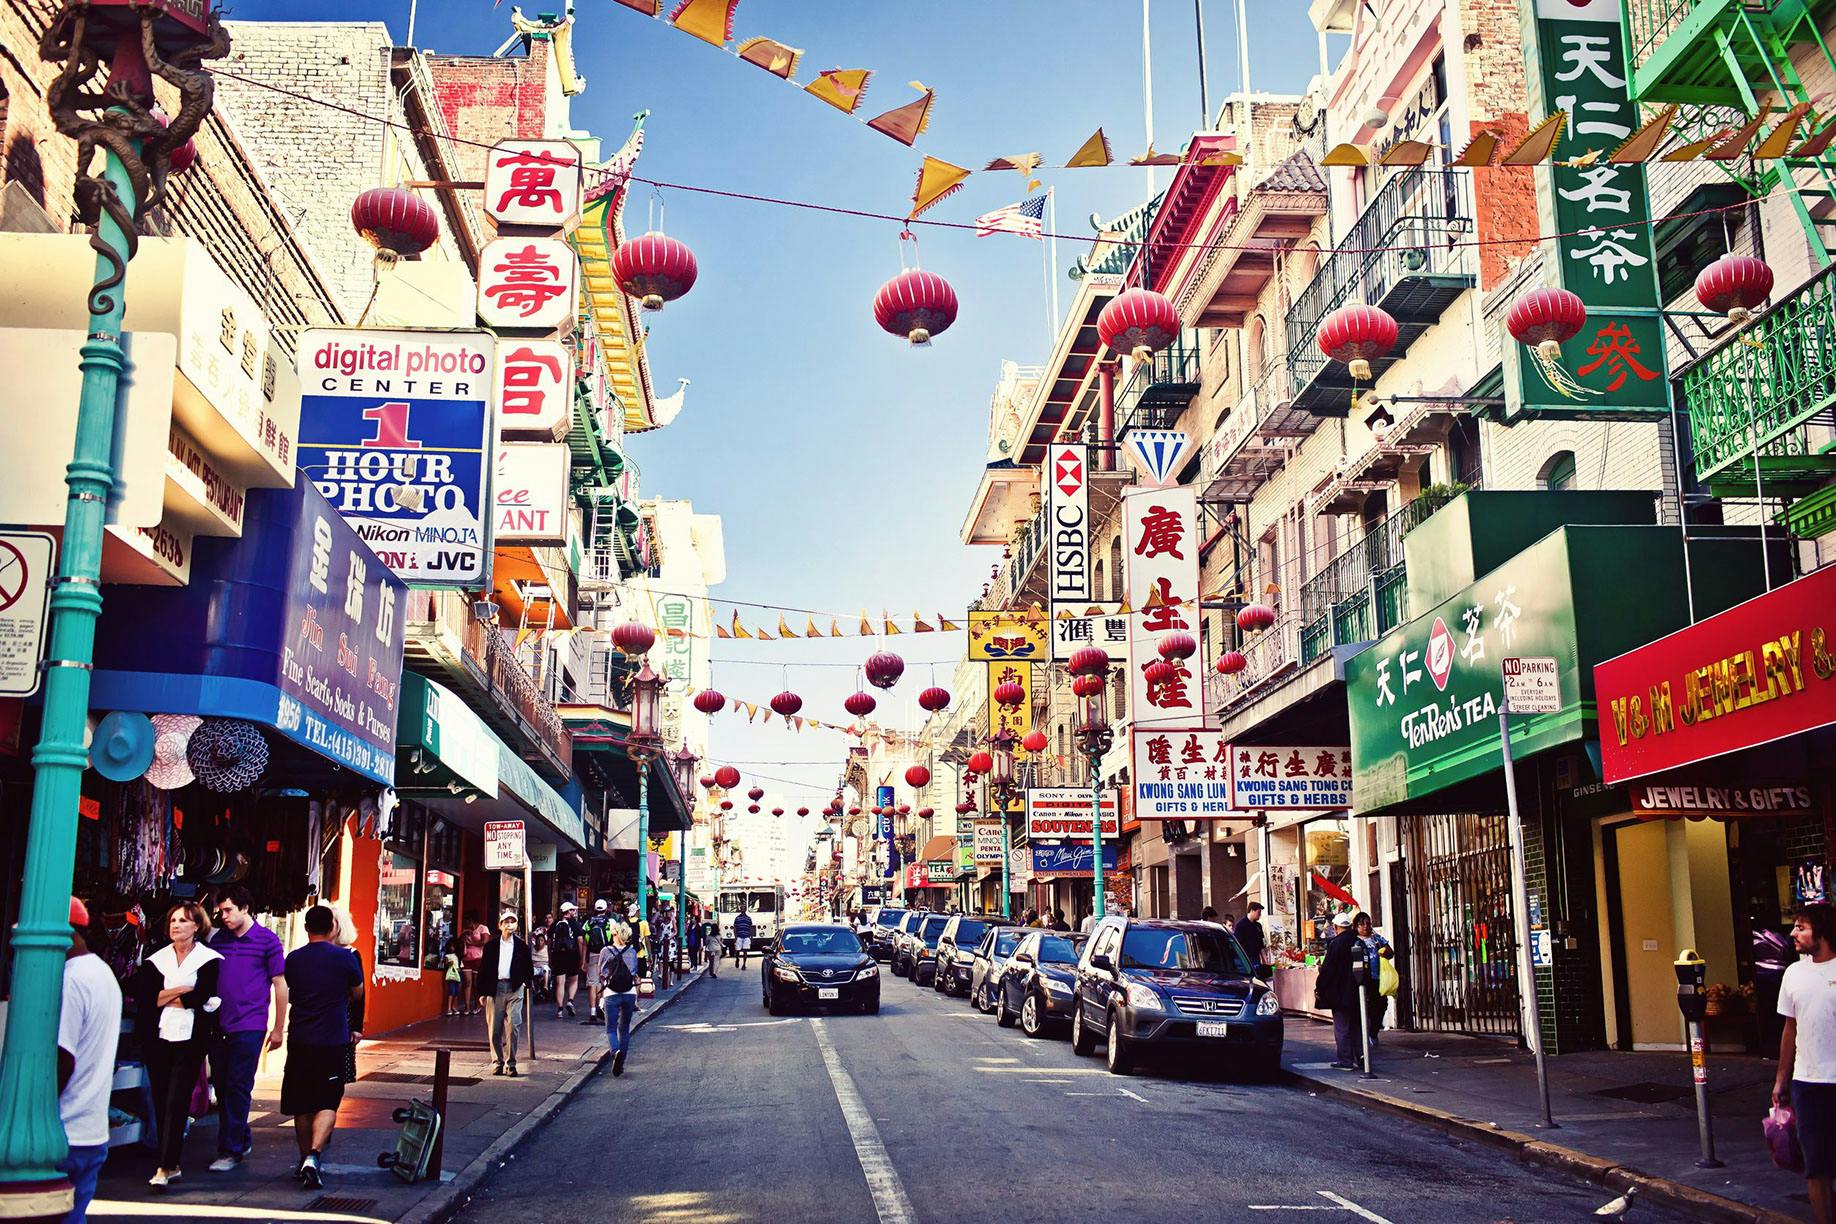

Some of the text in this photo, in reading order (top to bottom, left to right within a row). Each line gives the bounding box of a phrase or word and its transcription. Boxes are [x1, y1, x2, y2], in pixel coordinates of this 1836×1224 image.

[1555, 35, 1648, 285] 天仁茗茶
[314, 342, 485, 377] digital photo
[322, 378, 469, 395] CENTER
[362, 402, 422, 448] 1
[324, 451, 455, 483] HOUR
[203, 462, 244, 526] RESTAURANT
[313, 482, 465, 513] PHOTO
[357, 524, 410, 543] Nikon
[1056, 505, 1085, 595] HSBC
[427, 551, 476, 571] JVC
[1376, 584, 1522, 708] 天仁 茗茶
[301, 603, 324, 652] Jin
[336, 632, 358, 678] Sui
[366, 657, 396, 710] Fang
[1505, 659, 1555, 673] NO PARKING
[1509, 676, 1516, 687] 2
[1537, 677, 1543, 687] 6
[1680, 629, 1805, 726] JEWELRY
[282, 646, 303, 687] Fine
[305, 665, 333, 712] Scarfs,
[333, 687, 356, 722] Socks
[357, 701, 365, 726] &
[366, 706, 391, 744] Purses
[1464, 691, 1497, 727] TEA
[1139, 782, 1174, 799] KWONG
[1177, 782, 1204, 799] SANG
[1237, 780, 1276, 792] KWONG
[1278, 780, 1308, 792] SANG
[1310, 780, 1339, 792] TONG
[1155, 802, 1187, 812] GIFTS
[1190, 802, 1198, 812] &
[1248, 793, 1347, 805] GIFTS & HERBS
[1641, 786, 1812, 810] JEWELRY & GIFTS
[486, 830, 522, 841] NO STOPPING
[488, 822, 521, 830] TOW-AWAY
[1031, 820, 1117, 833] SOUVENRS
[496, 851, 513, 859] TIME
[497, 842, 512, 850] ANY
